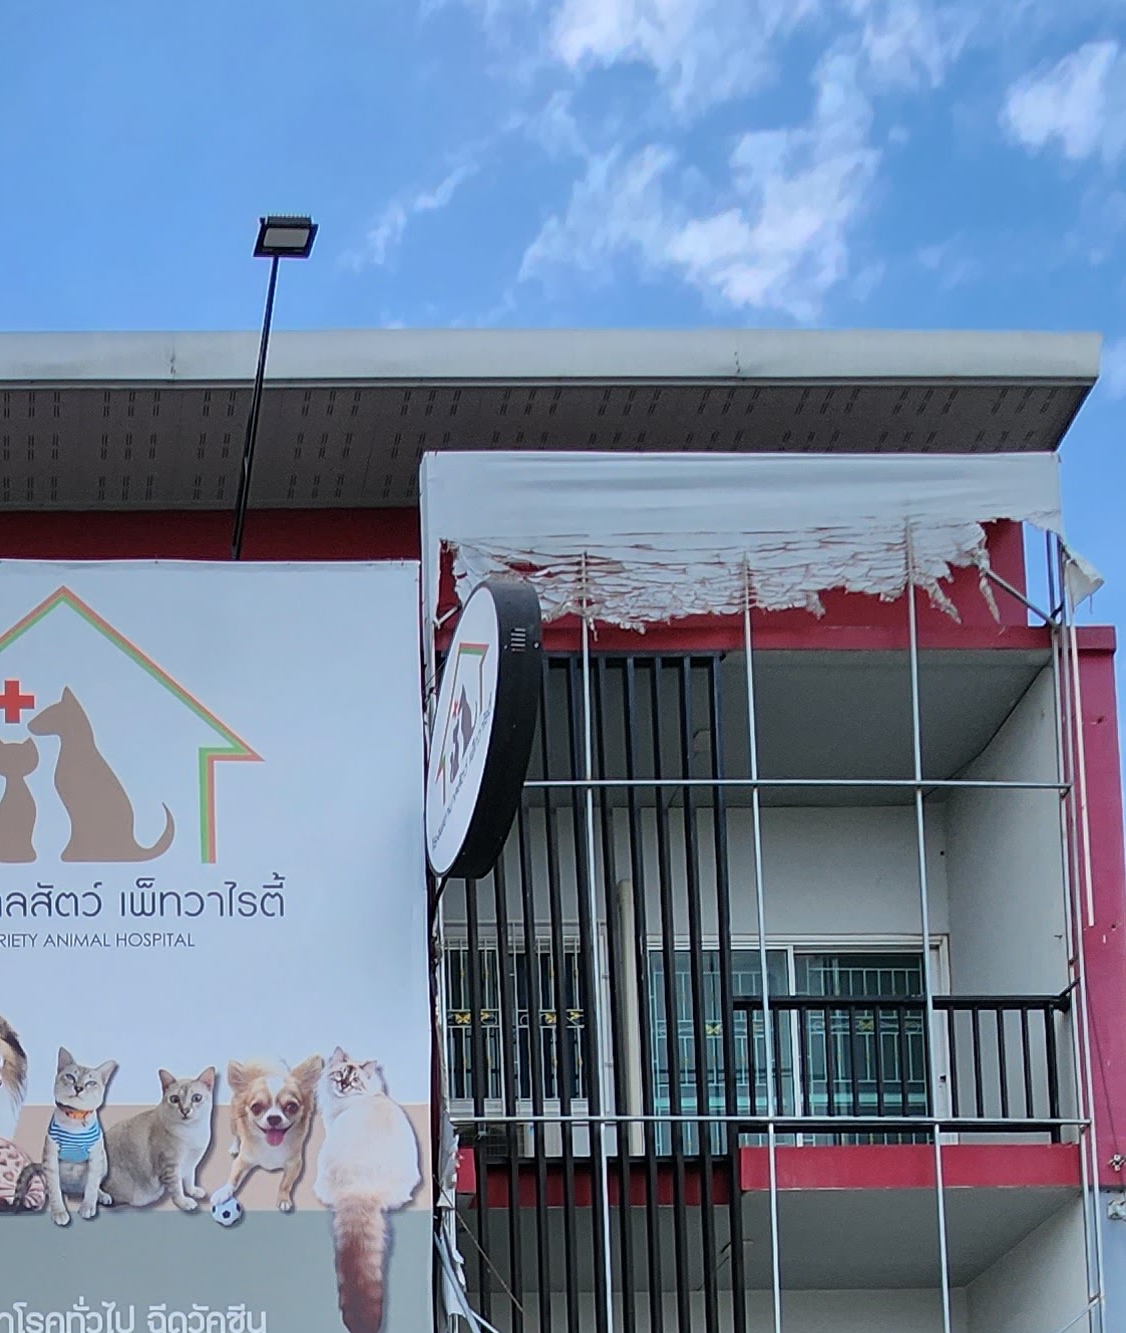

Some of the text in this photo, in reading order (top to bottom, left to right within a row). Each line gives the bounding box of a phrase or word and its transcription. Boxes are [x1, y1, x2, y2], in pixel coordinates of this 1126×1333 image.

[121, 872, 285, 917] เพ็ทวาไรตี้
[43, 933, 110, 947] ANIMAL
[117, 933, 195, 947] HOSPITAL
[147, 1304, 266, 1333] ฉีดวัคซีน
